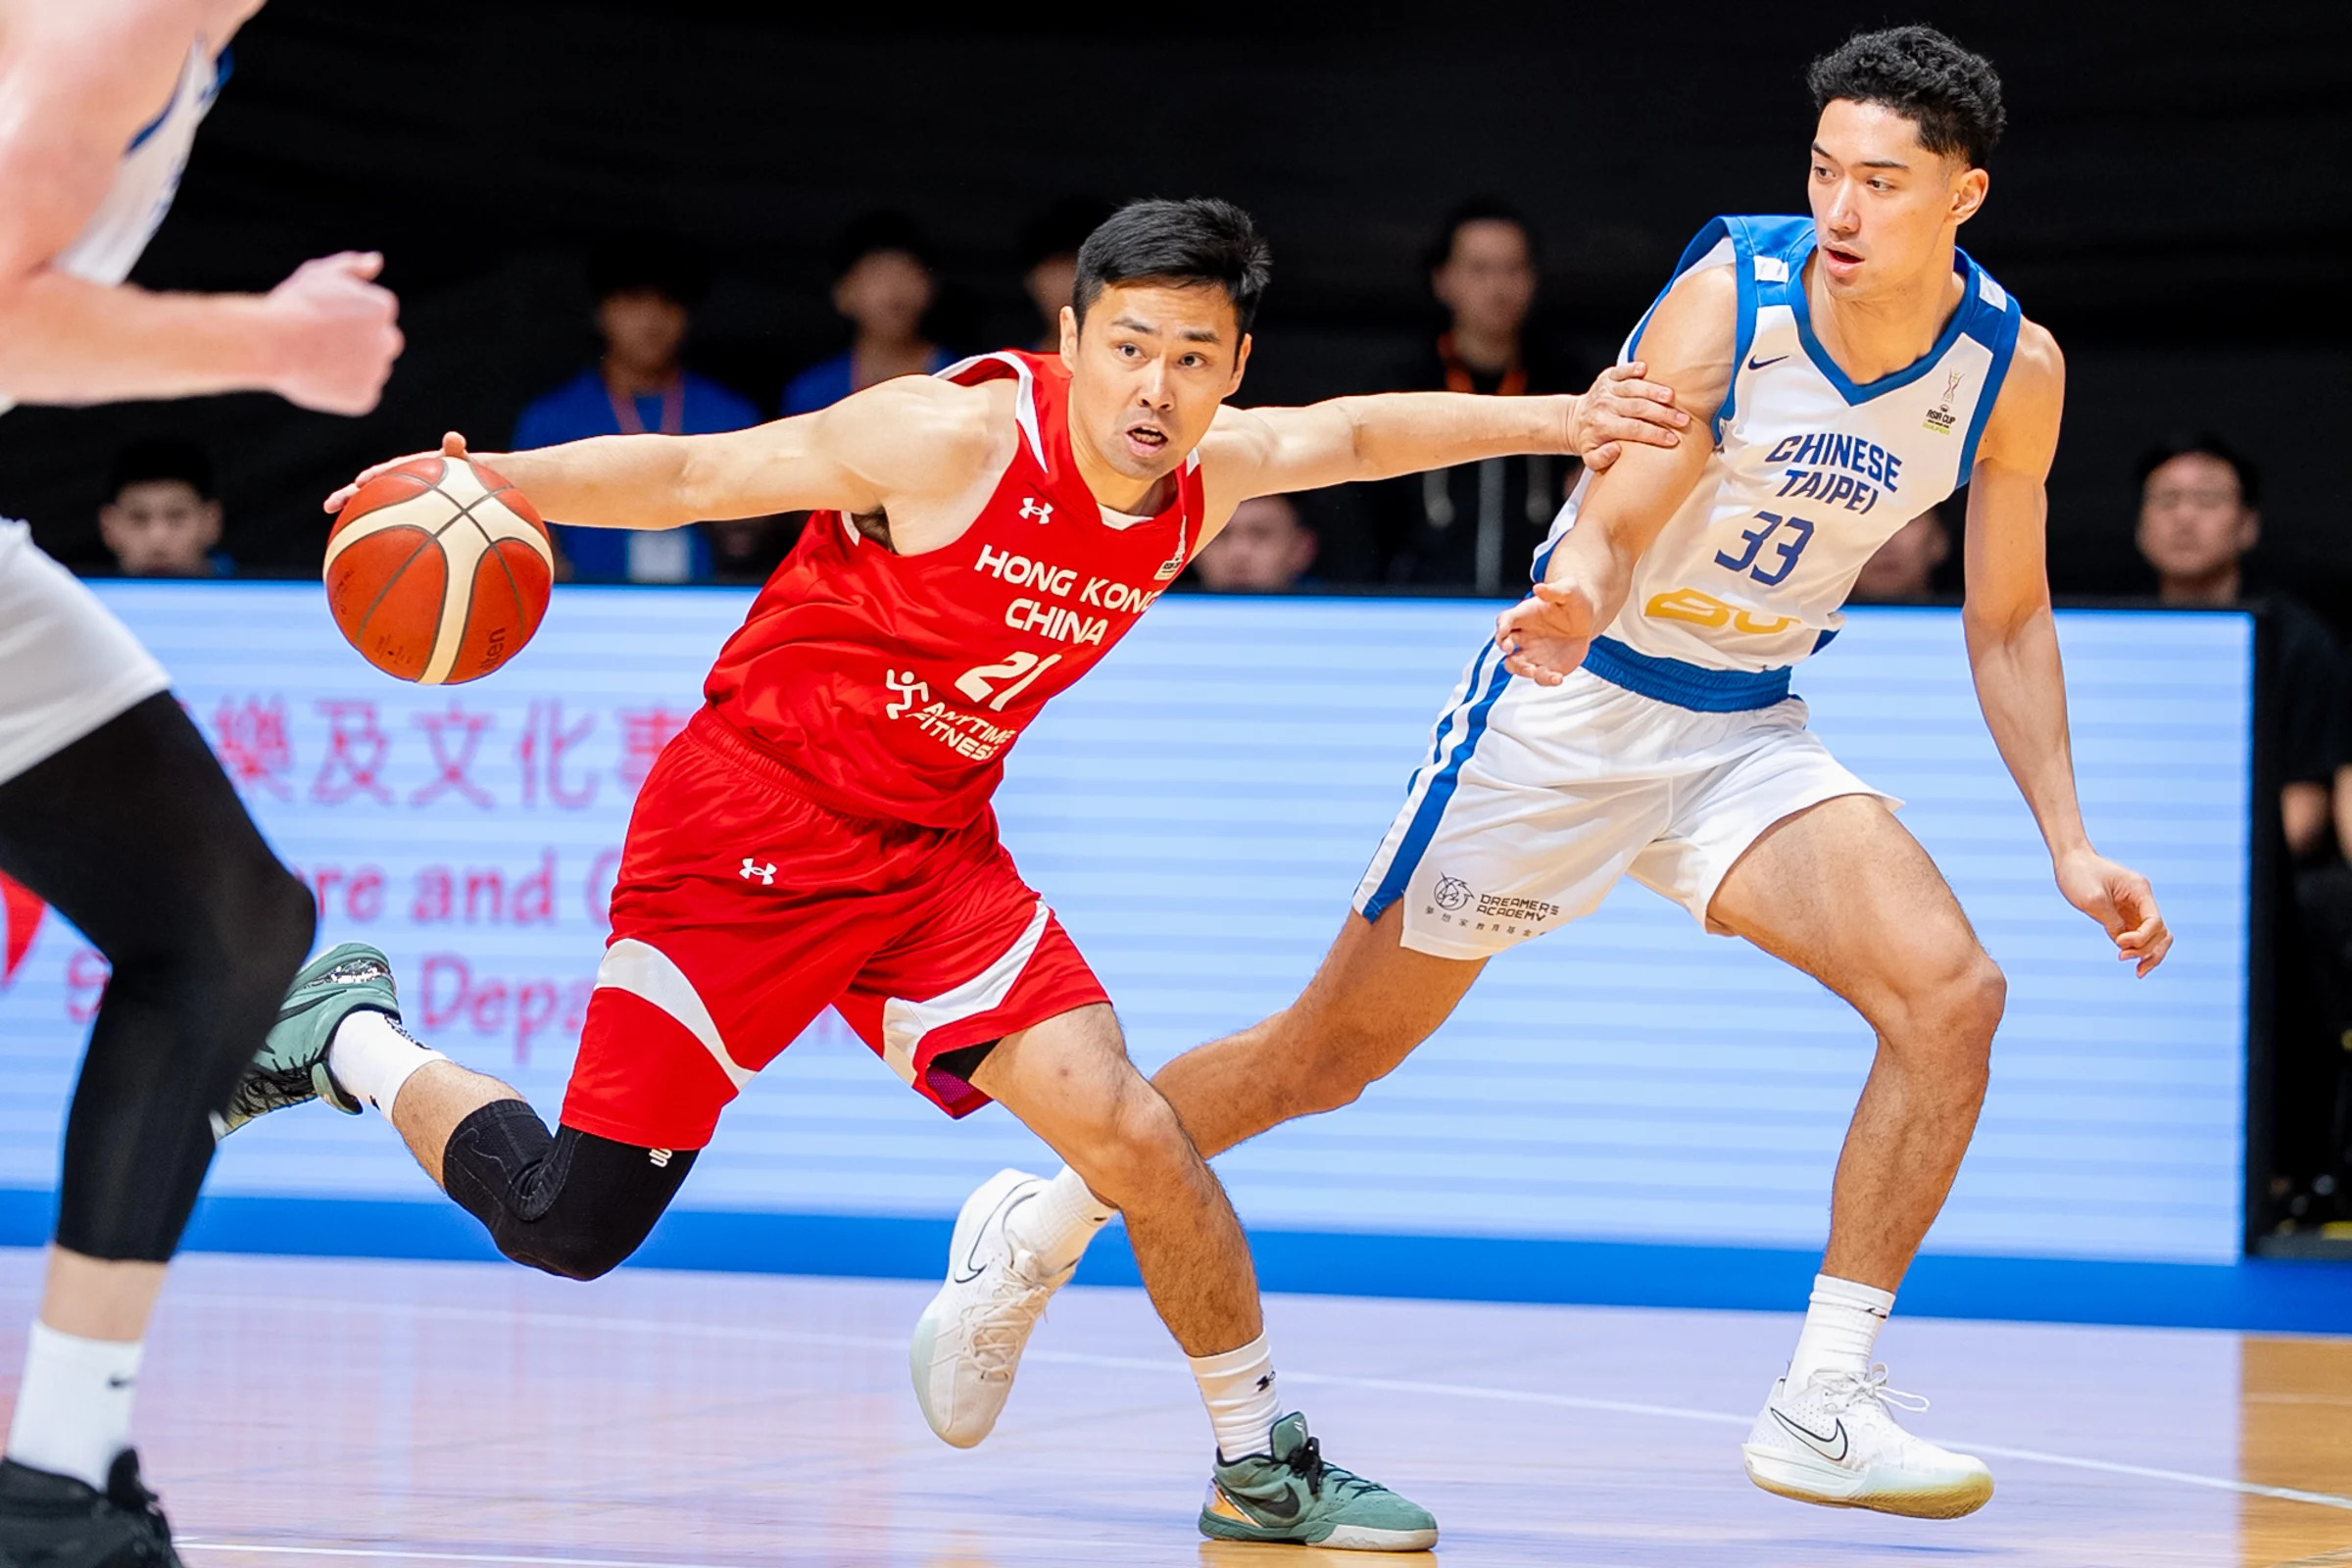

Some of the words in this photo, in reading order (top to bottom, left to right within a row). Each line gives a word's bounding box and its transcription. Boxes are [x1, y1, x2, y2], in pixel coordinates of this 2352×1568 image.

[1765, 433, 1903, 493] CHINESE
[1776, 469, 1880, 515] TAIPEI
[1714, 510, 1815, 587] 33
[974, 544, 1078, 598] HONG
[1079, 576, 1163, 615] KONG
[1004, 598, 1109, 647] CHINA
[954, 651, 1062, 713] 21
[922, 702, 1017, 746] ANYTIME
[410, 849, 556, 926] and
[1476, 905, 1546, 922] ACADEMY
[1479, 893, 1560, 916] DREAMERS
